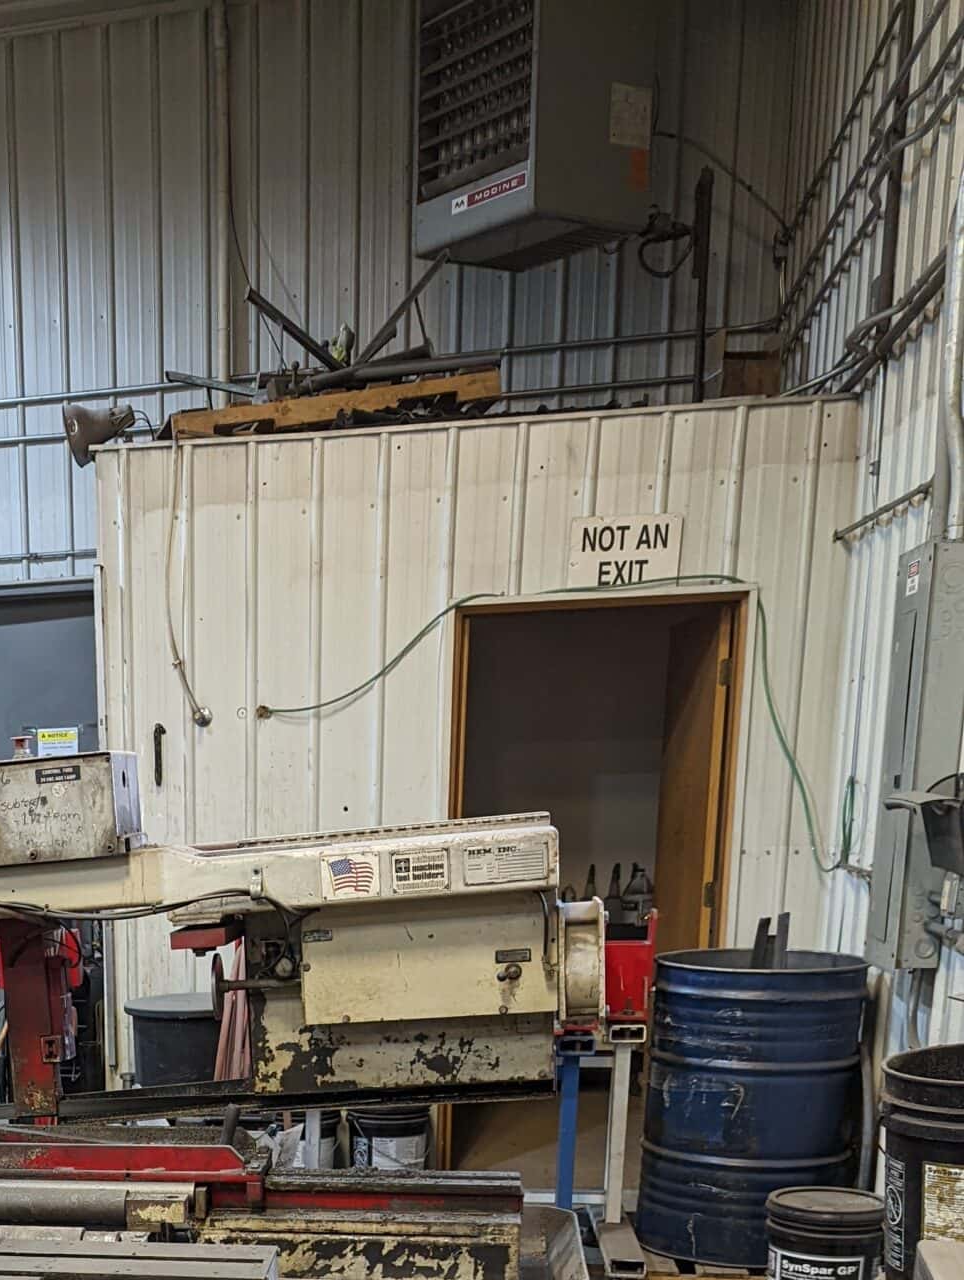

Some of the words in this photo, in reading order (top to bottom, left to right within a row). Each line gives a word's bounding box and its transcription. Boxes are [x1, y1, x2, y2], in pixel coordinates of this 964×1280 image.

[474, 179, 518, 201] MODINE
[581, 525, 631, 552] NOT
[636, 523, 669, 550] AN
[598, 559, 649, 586] EXIT
[781, 1259, 835, 1276] SynSpar
